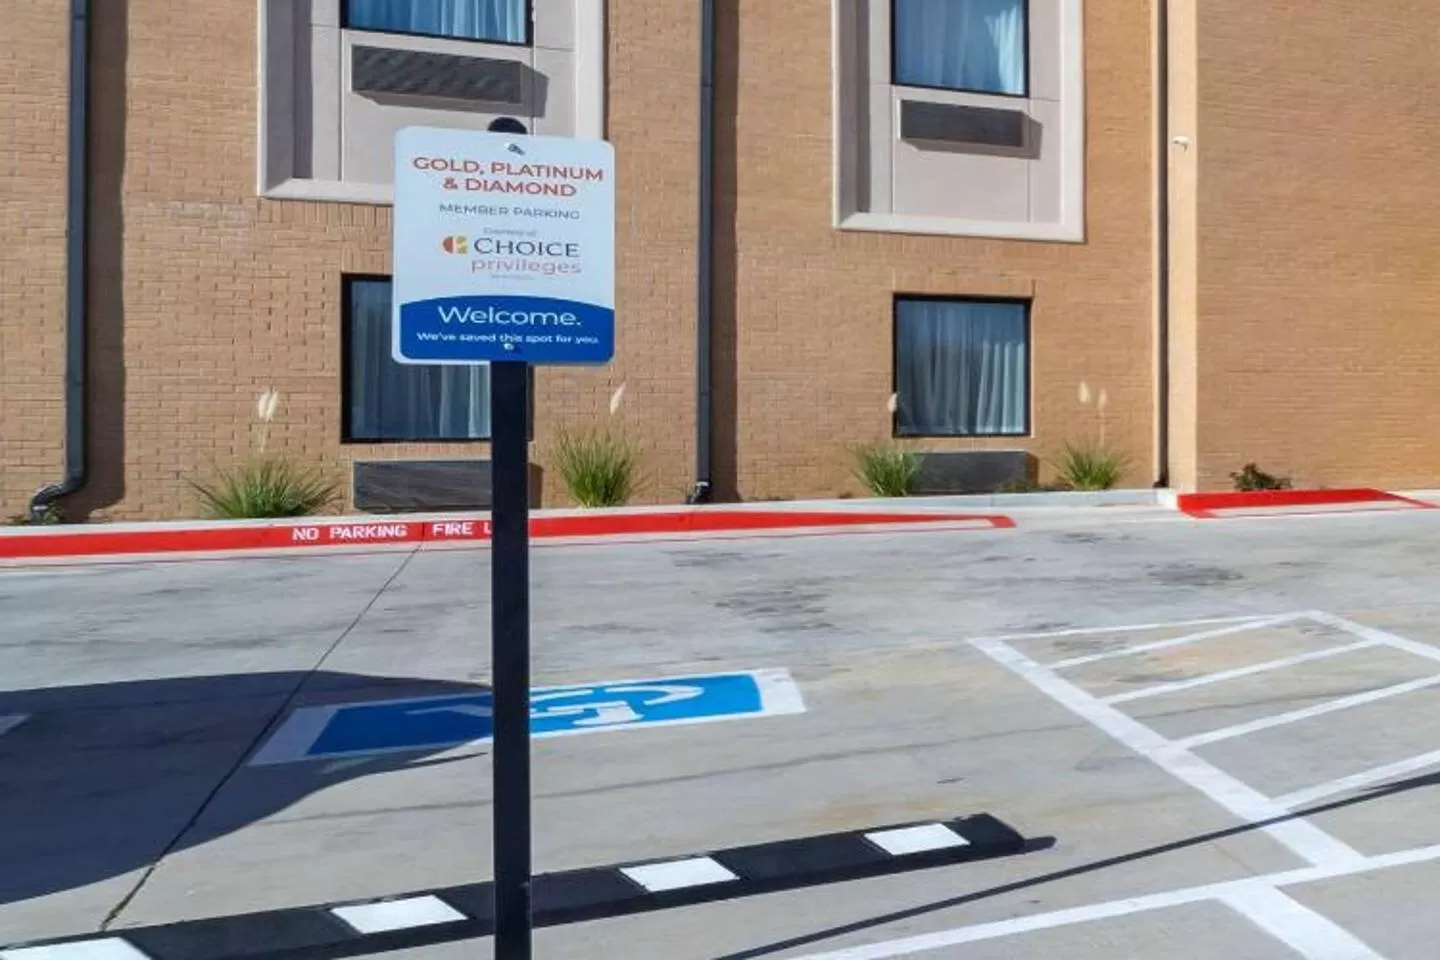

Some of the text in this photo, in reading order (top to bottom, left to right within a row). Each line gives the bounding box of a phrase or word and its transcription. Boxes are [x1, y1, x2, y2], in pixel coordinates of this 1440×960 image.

[413, 156, 604, 181] GOLD, PLATINUM
[442, 177, 577, 197] & DIAMOND
[439, 203, 581, 220] MEMBER PARKING
[473, 237, 580, 258] CHOICE
[471, 258, 582, 275] privileges
[438, 305, 582, 326] Welcome.
[459, 333, 496, 342] saved
[500, 333, 523, 343] this
[525, 334, 553, 344] spot
[556, 334, 572, 343] for
[292, 527, 318, 541] NO
[329, 524, 408, 539] PARKING
[432, 521, 473, 536] FIRE
